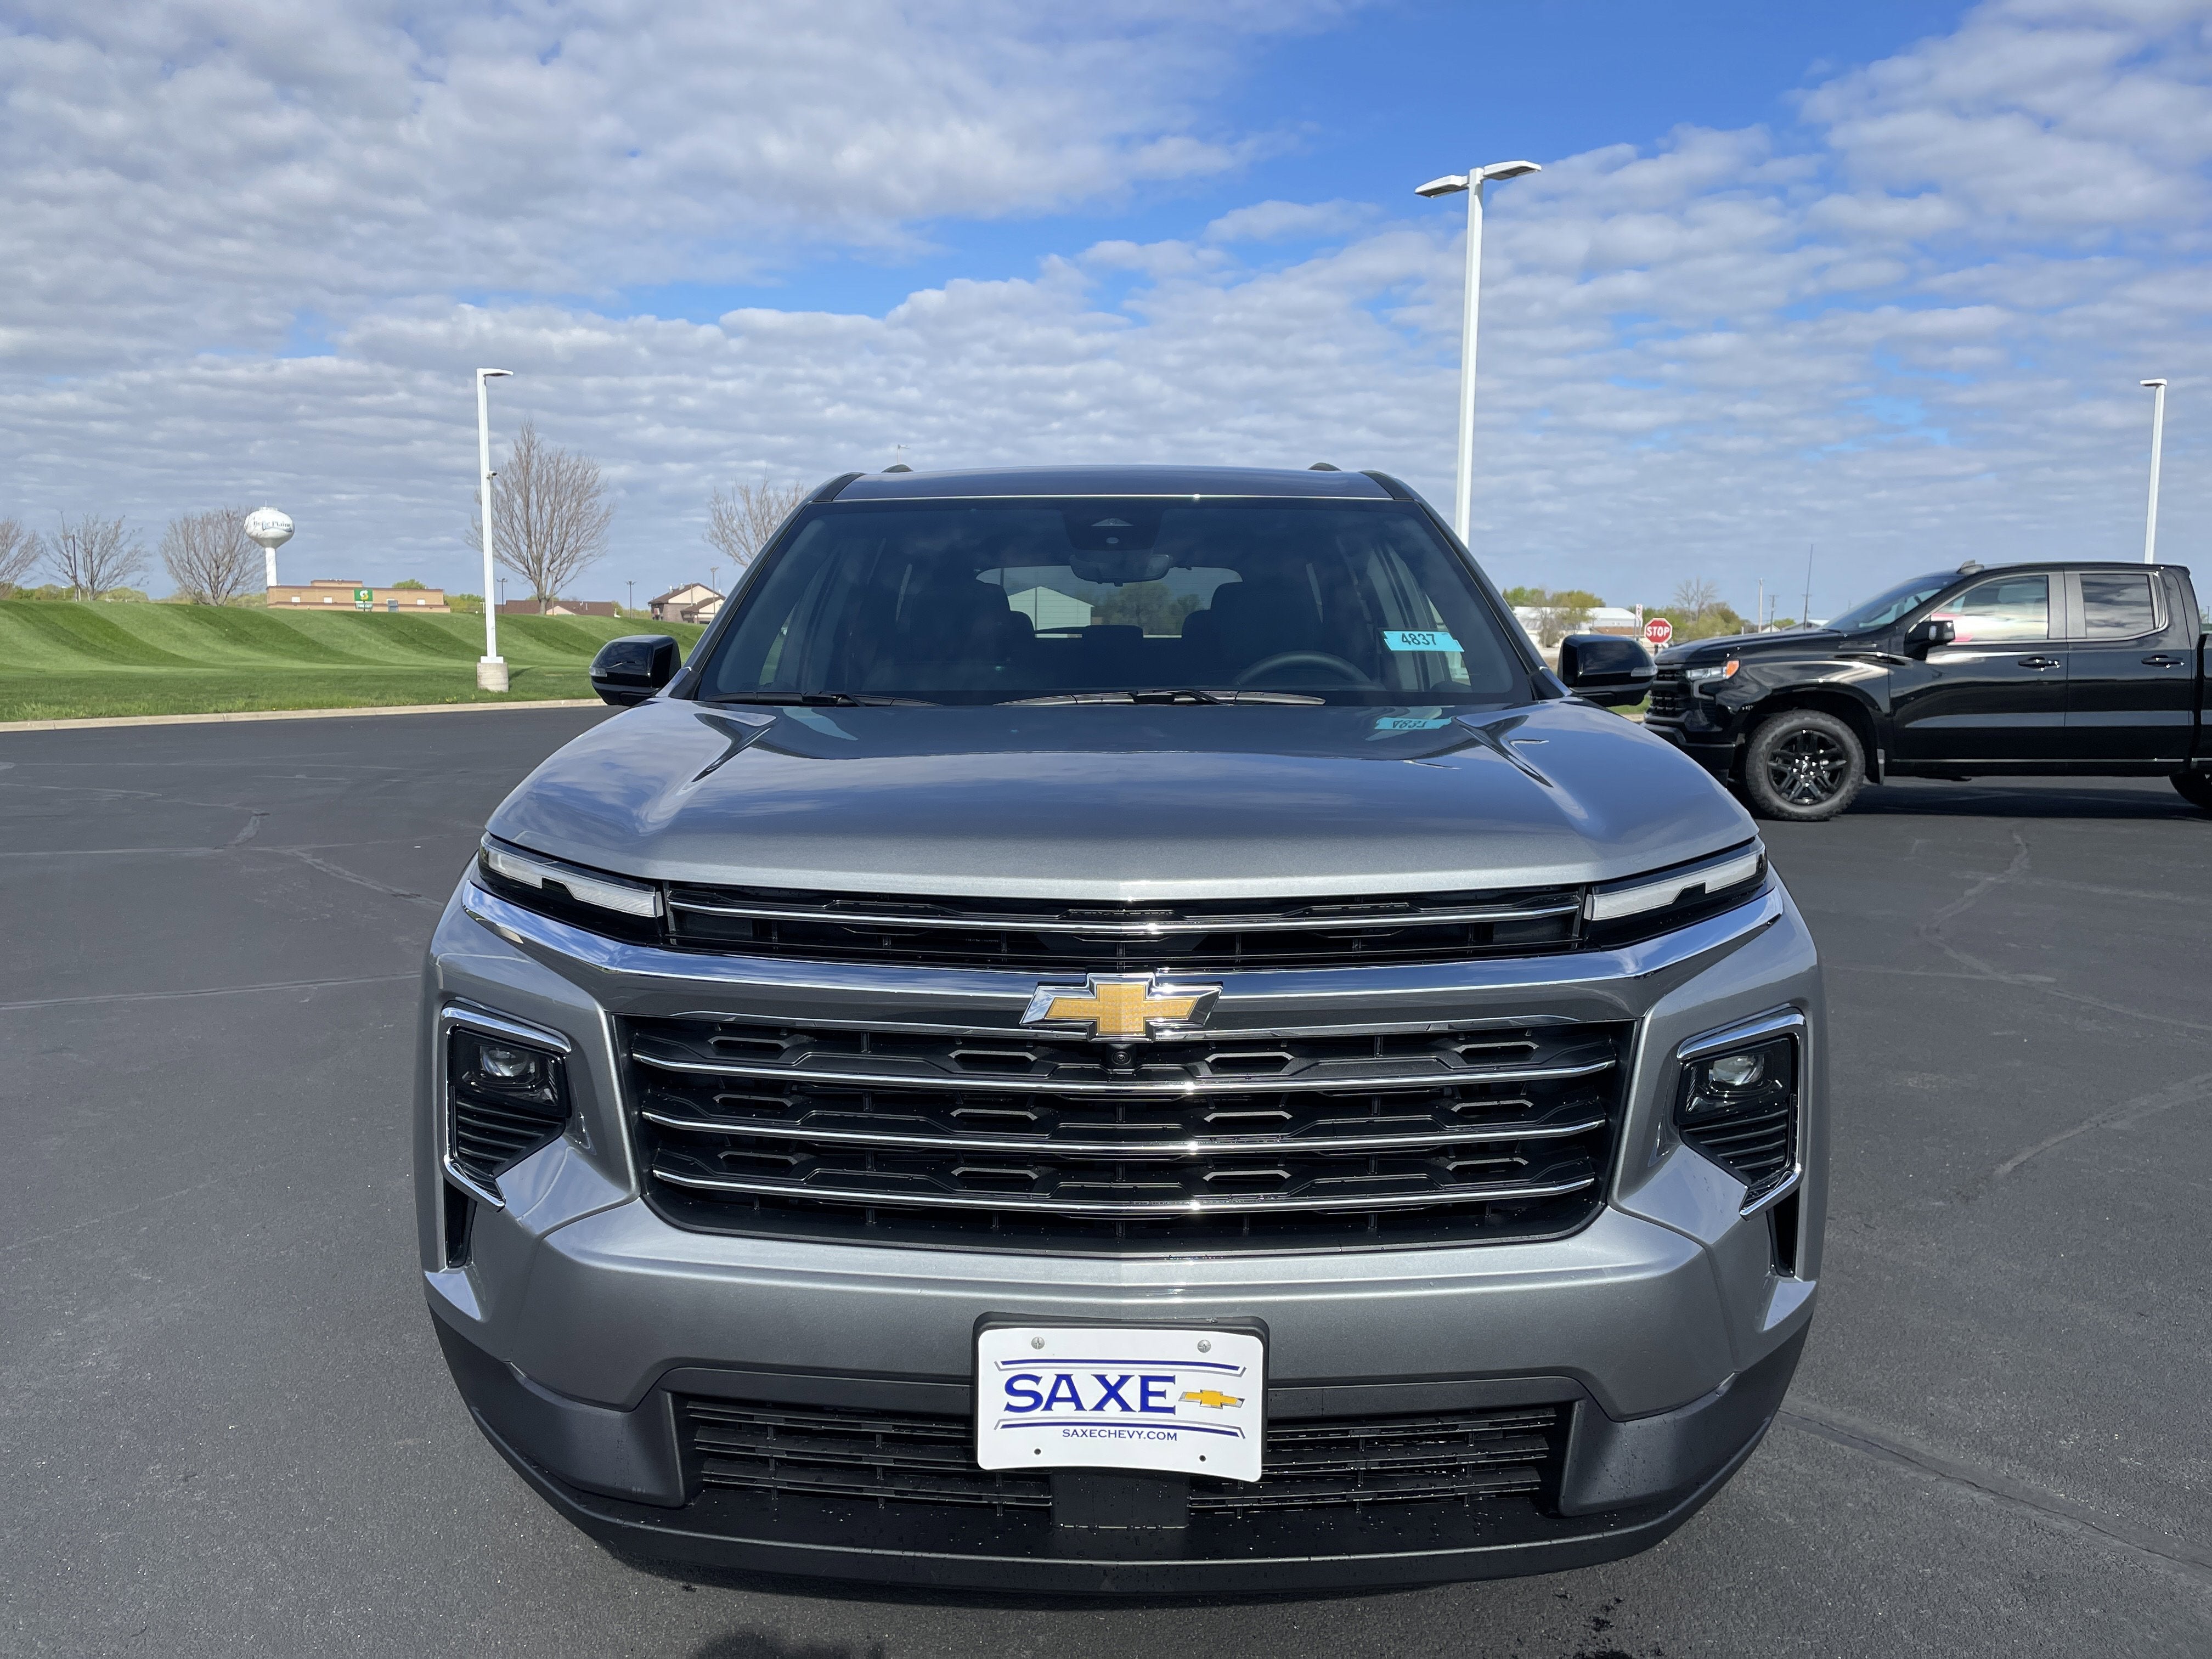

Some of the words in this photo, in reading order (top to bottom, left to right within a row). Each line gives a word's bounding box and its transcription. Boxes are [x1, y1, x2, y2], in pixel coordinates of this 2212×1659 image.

[1646, 626, 1670, 637] STOP
[1401, 633, 1437, 646] 4837
[1003, 1374, 1176, 1415] SAXE
[1062, 1429, 1178, 1441] SAXECHEVY.COM
